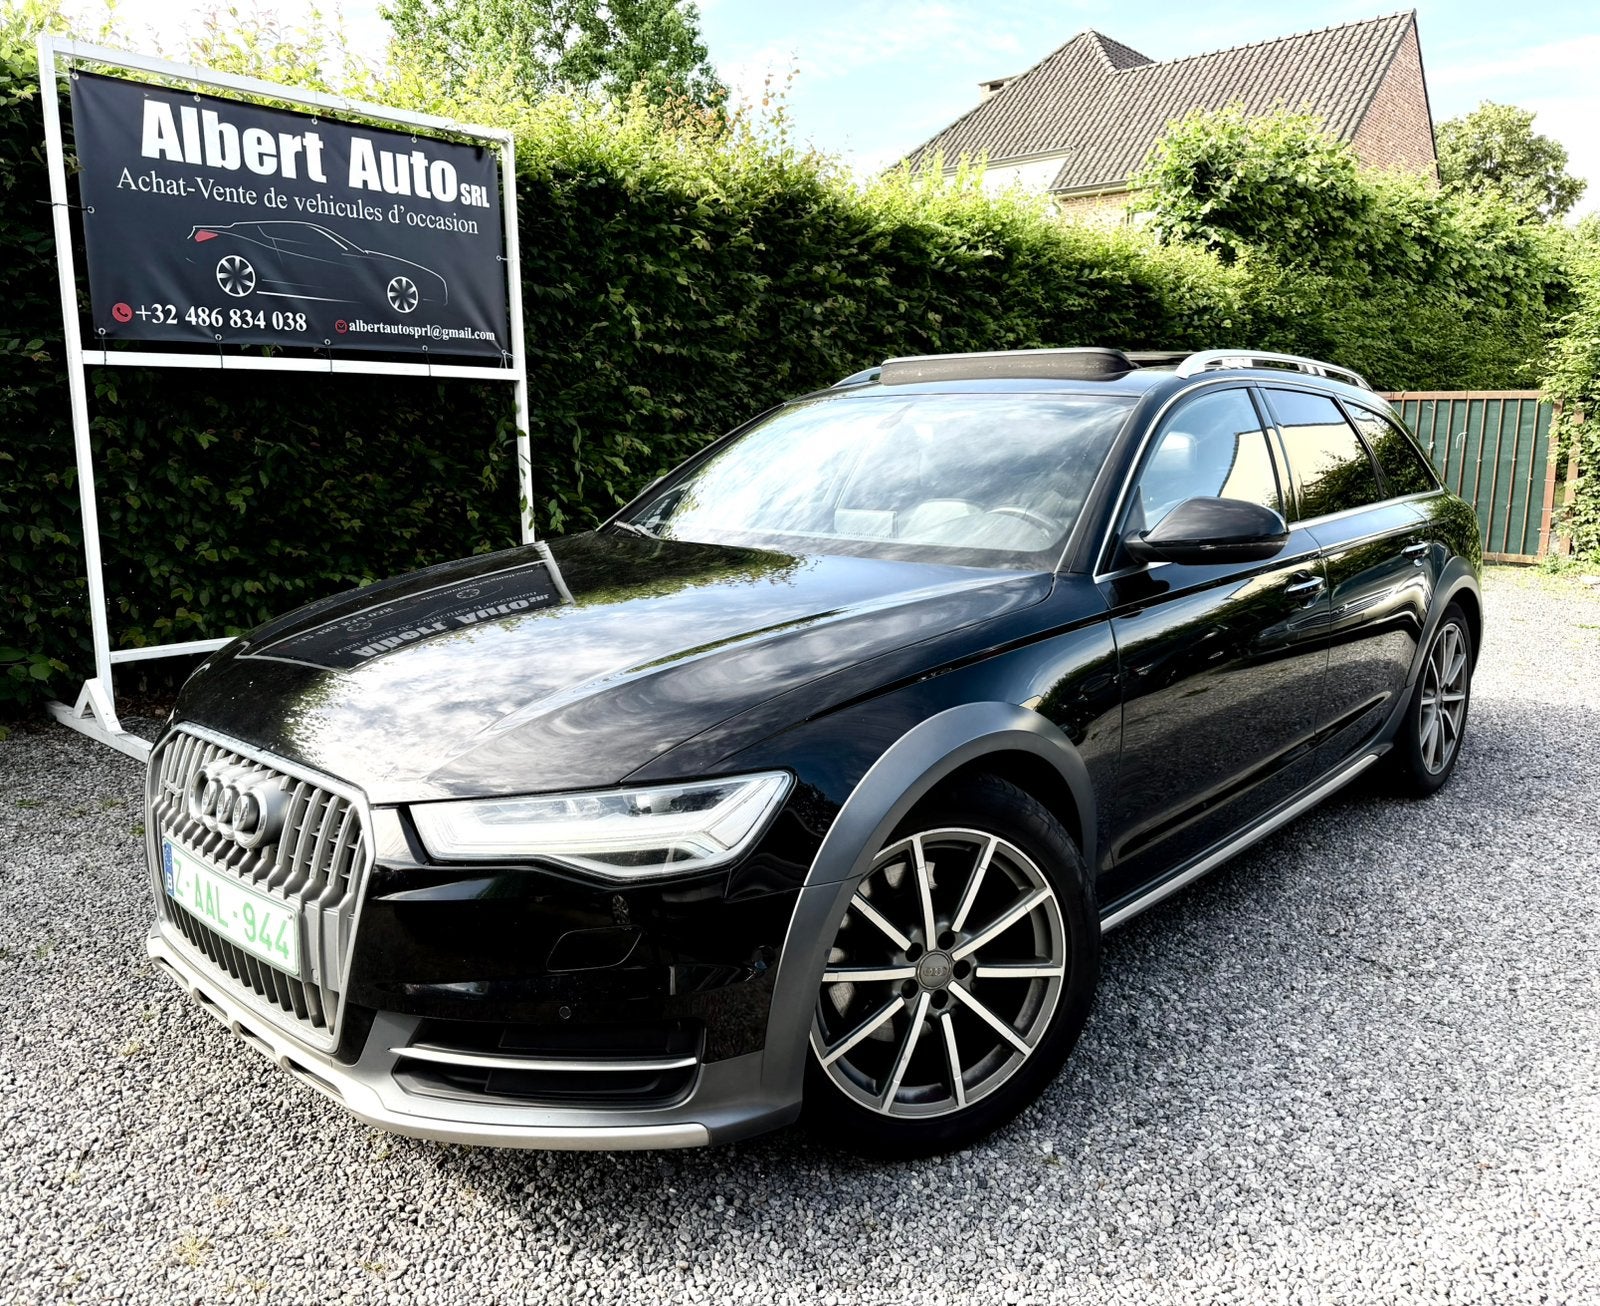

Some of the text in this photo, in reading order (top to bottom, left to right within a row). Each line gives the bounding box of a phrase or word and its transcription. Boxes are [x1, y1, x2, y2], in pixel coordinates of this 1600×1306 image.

[141, 99, 491, 208] Albert Auto SRL
[116, 167, 258, 205] Achat-Vente
[263, 187, 288, 209] de
[293, 193, 383, 222] vehicules
[135, 304, 308, 332] +32 486 834 038
[349, 319, 496, 341] albertautosprl@gmail.com
[167, 872, 173, 889] B
